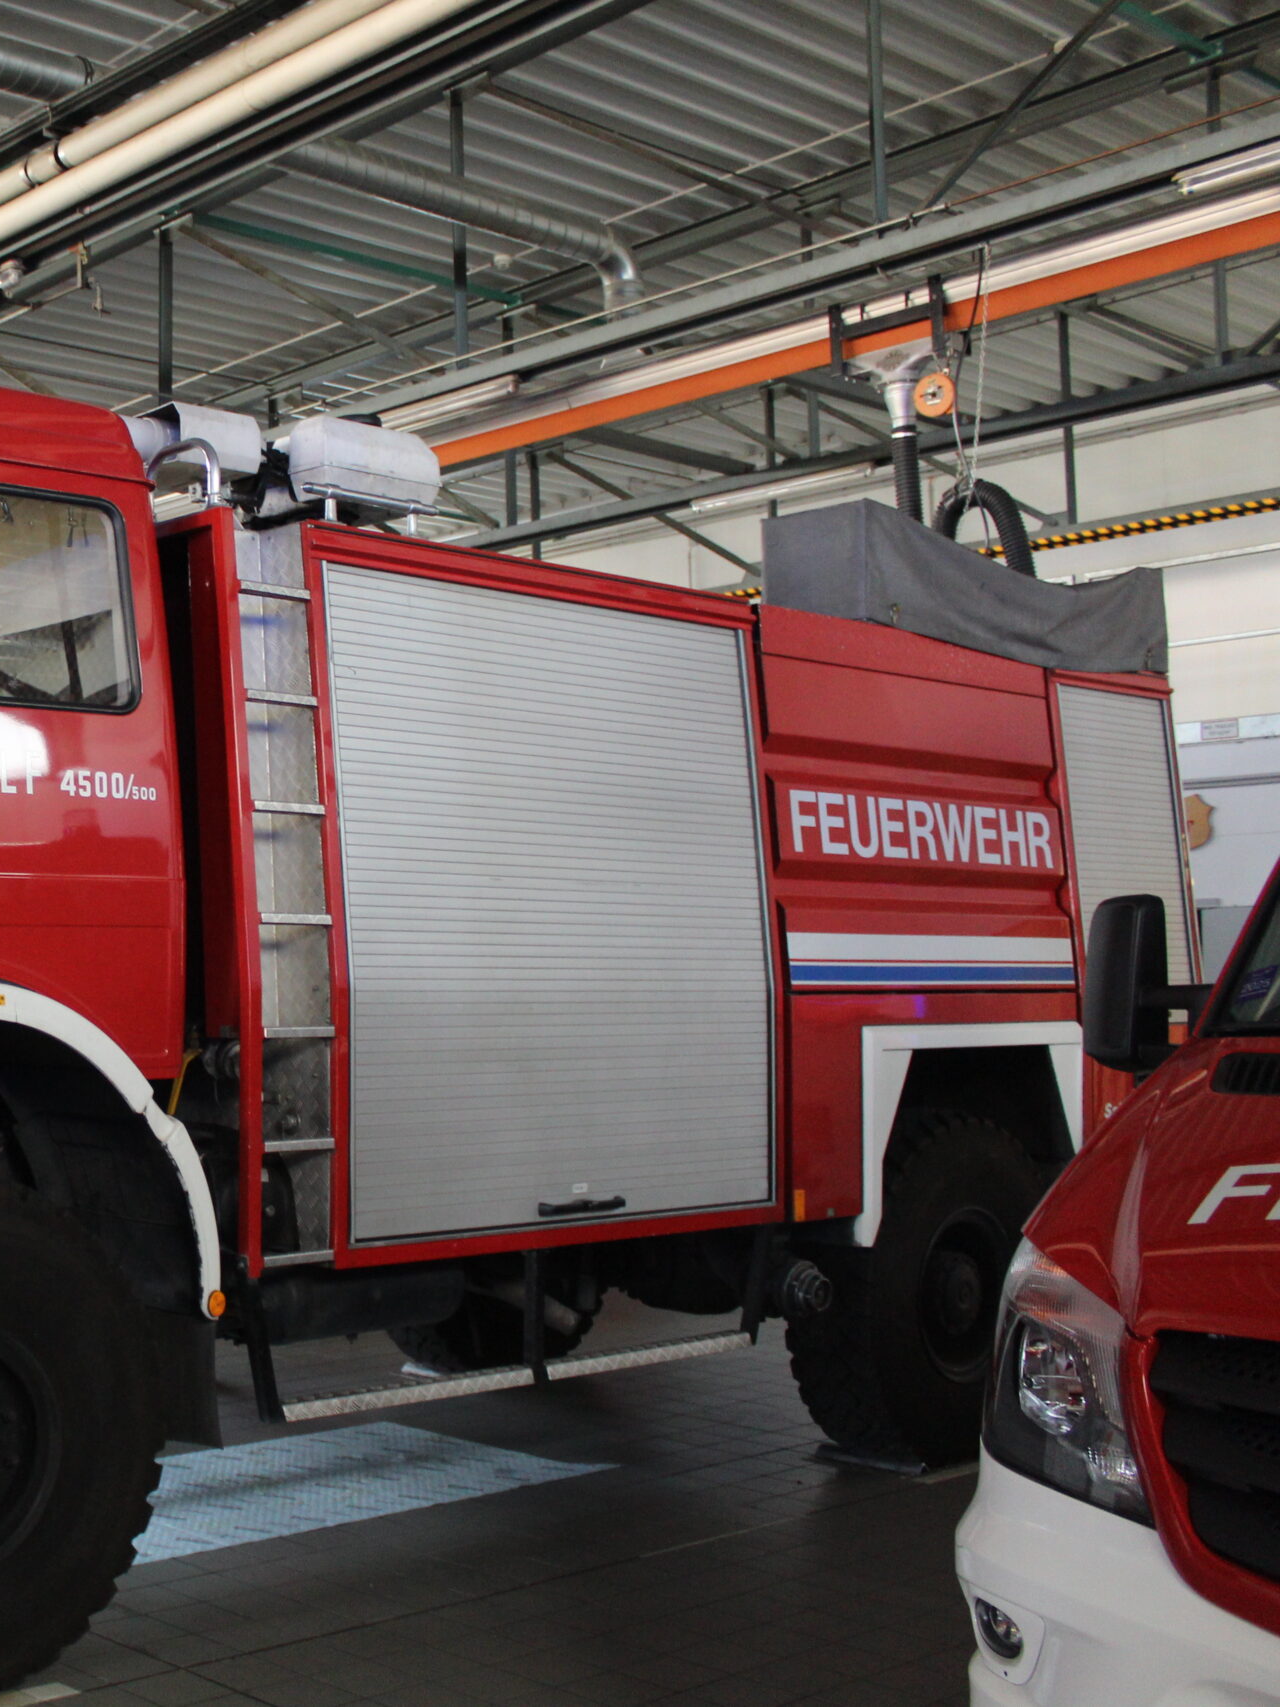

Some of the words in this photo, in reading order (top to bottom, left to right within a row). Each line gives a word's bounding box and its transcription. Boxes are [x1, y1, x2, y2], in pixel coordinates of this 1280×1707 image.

[59, 769, 157, 801] 4500/500
[788, 789, 1055, 869] FEUERWEHR
[1186, 1163, 1280, 1225] F
